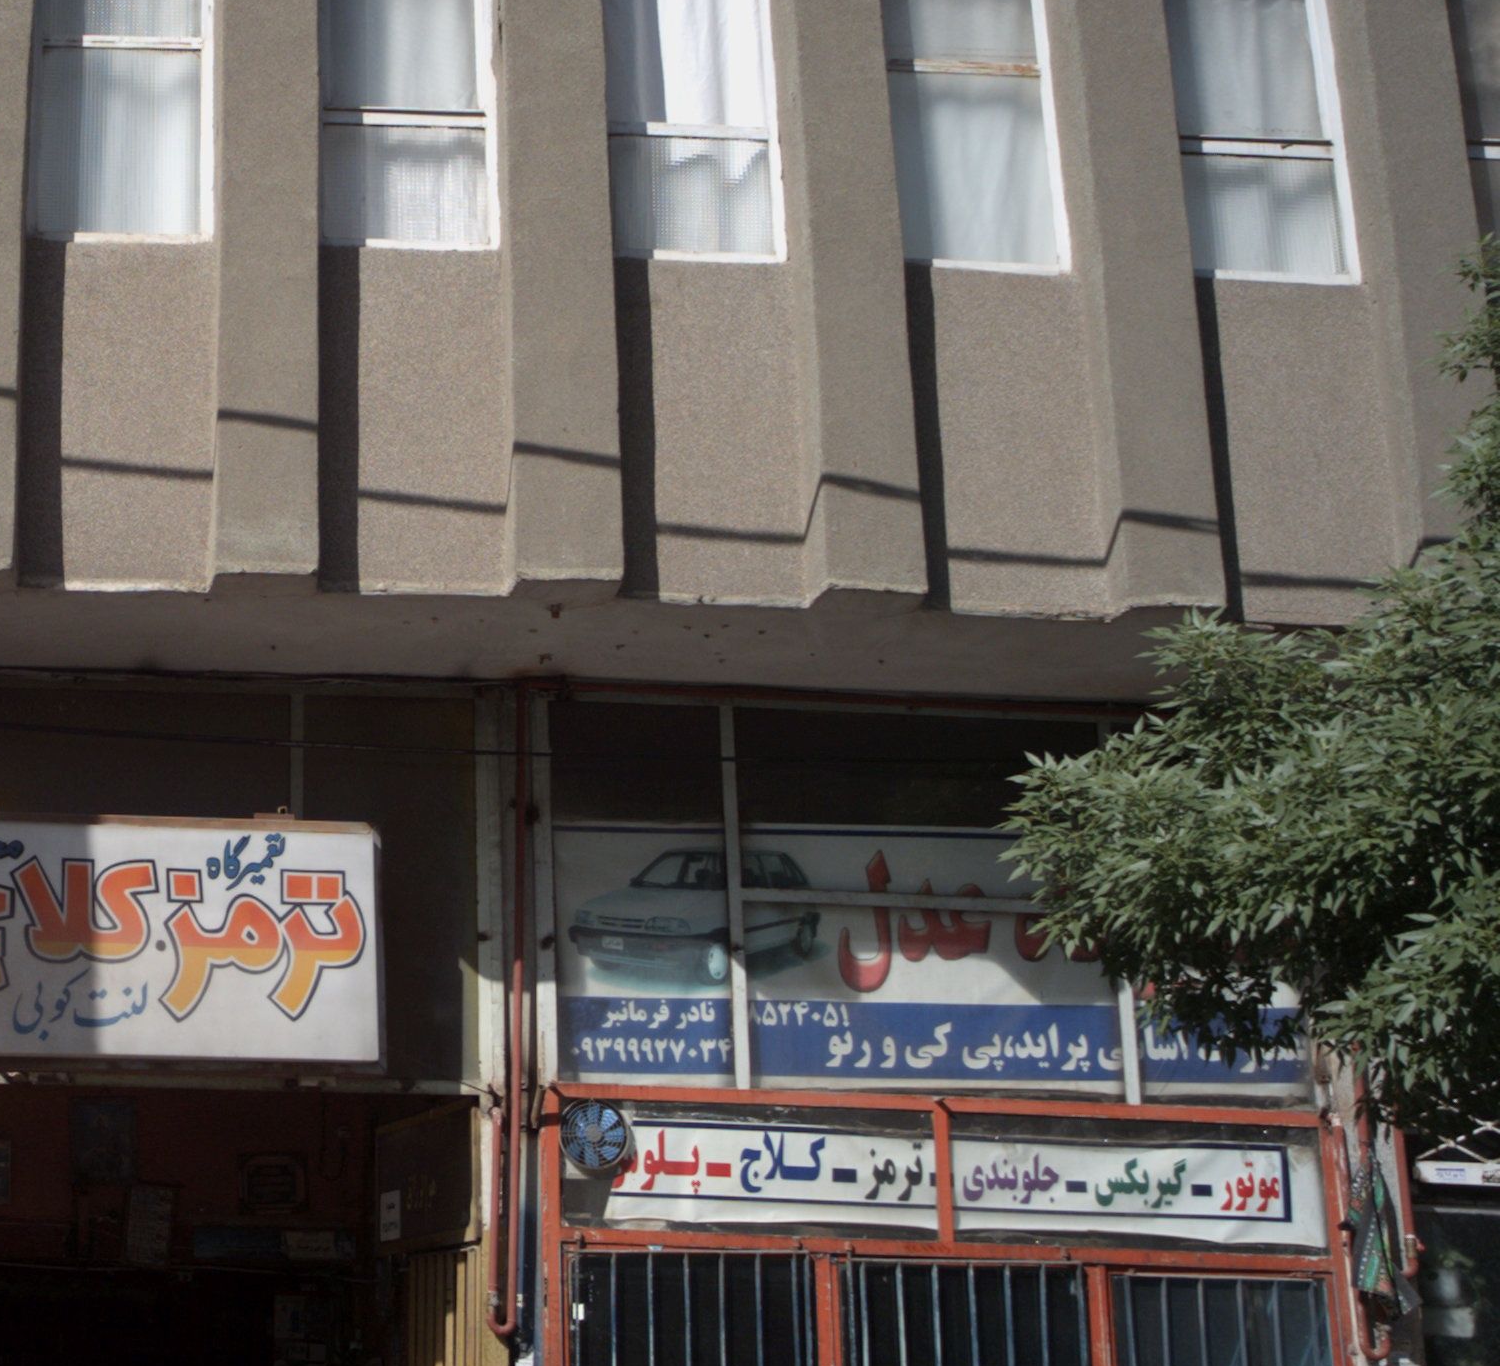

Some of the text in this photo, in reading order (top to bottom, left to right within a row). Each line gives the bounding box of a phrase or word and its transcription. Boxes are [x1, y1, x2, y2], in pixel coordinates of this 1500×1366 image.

[206, 832, 285, 890] تعمیرگاه
[159, 869, 365, 1022] ترمز
[13, 969, 148, 1040] لنت کوبی
[676, 999, 715, 1029] نادر
[571, 1037, 732, 1063] ۰۹۳۹۹۹۲۷۰۳۴
[880, 1035, 896, 1068] و
[905, 1022, 952, 1068] کی
[740, 1132, 825, 1192] کلاج
[864, 1142, 923, 1201] ترمز
[1095, 1158, 1187, 1209] گیربکس
[1220, 1162, 1280, 1212] موتور
